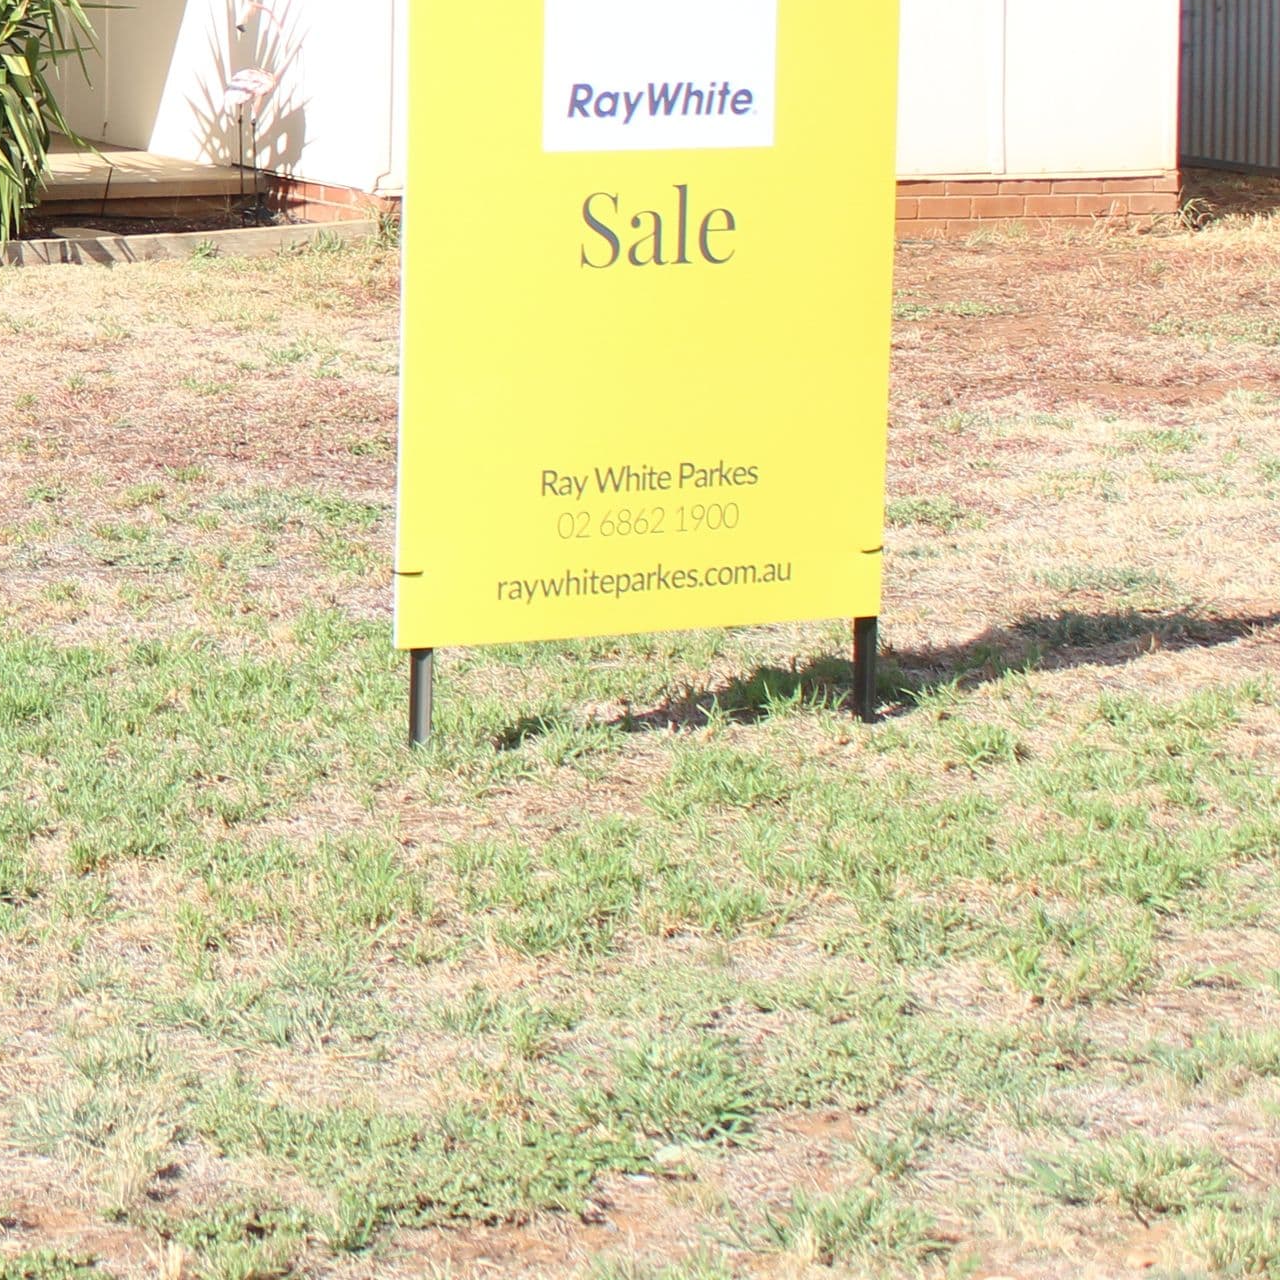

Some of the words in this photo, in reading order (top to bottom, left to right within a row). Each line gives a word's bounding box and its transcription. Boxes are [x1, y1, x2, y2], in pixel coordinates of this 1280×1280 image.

[580, 183, 737, 269] Sale
[541, 469, 589, 501] Ray
[594, 463, 673, 494] White
[678, 459, 759, 489] Parkes
[556, 511, 591, 540] 02
[599, 506, 666, 538] 6862
[676, 502, 740, 533] 1900
[497, 561, 792, 605] raywhiteparkes.com.au
